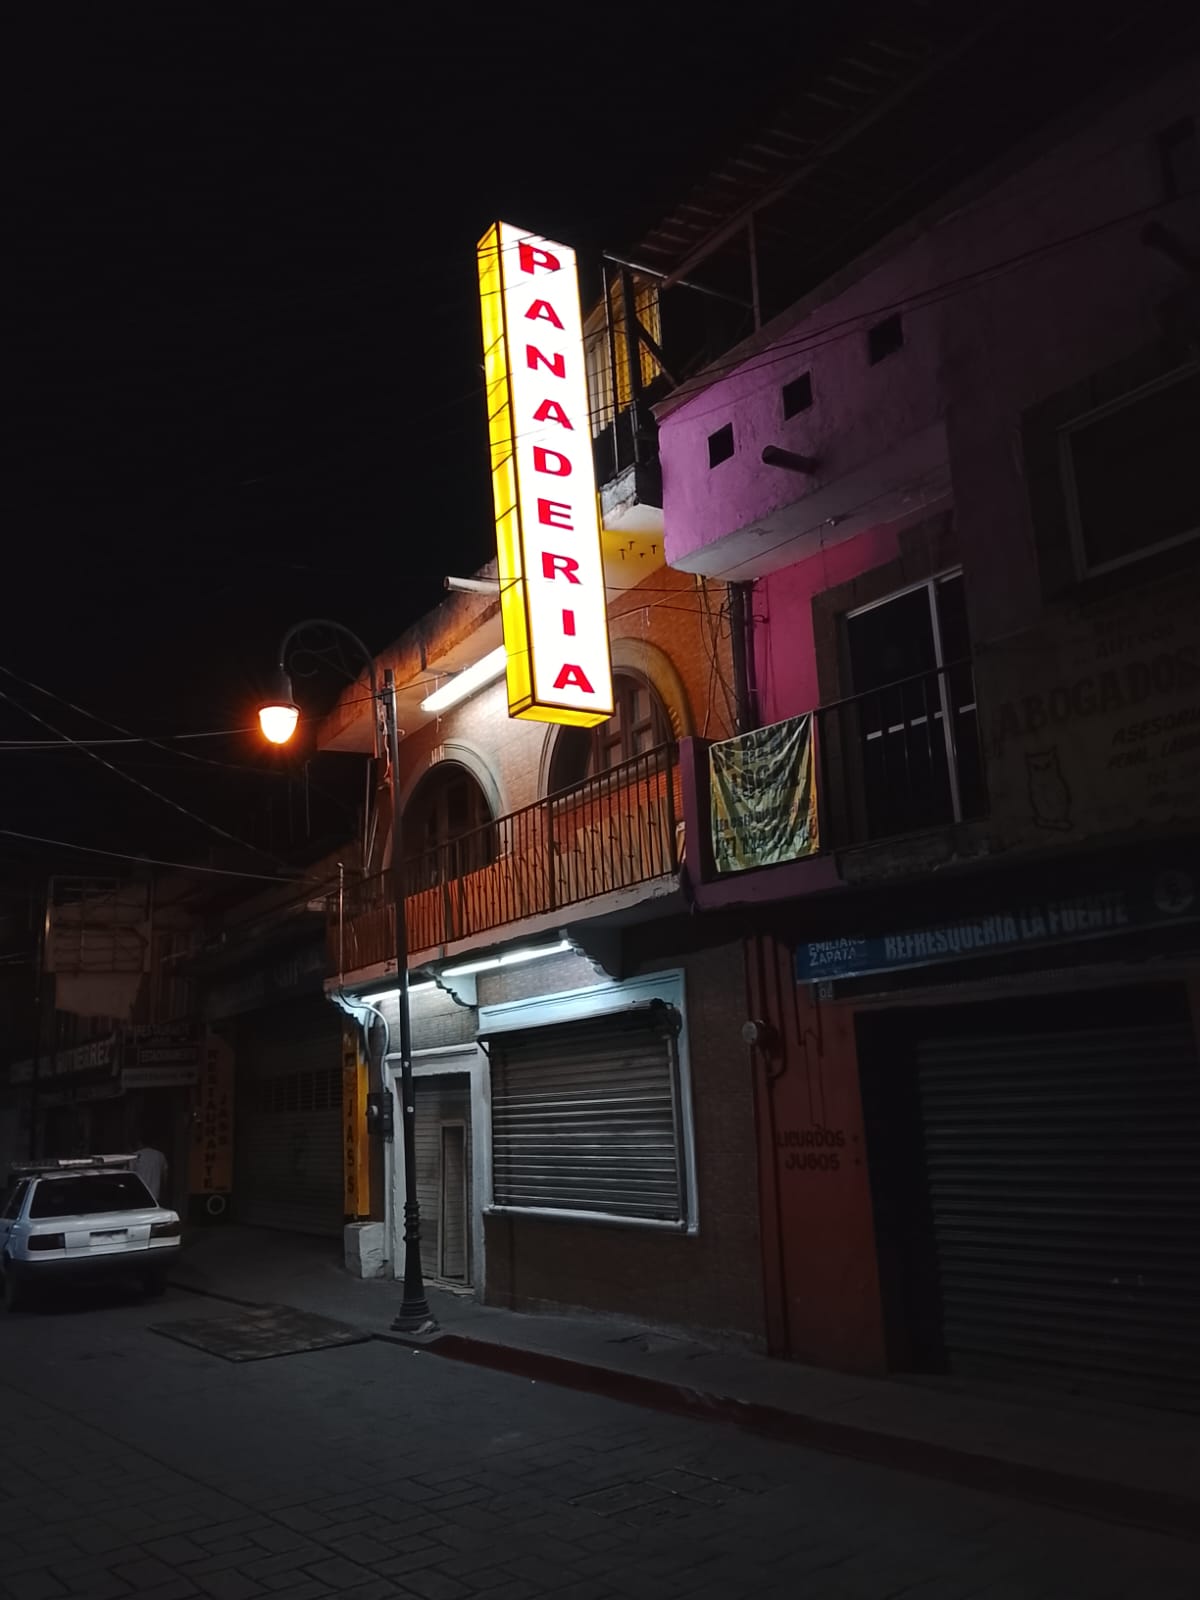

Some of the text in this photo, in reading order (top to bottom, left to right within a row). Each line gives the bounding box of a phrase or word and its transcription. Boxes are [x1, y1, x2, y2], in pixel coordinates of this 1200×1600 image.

[518, 240, 596, 694] PANADERIA
[1020, 904, 1046, 937] LA
[1047, 890, 1129, 936] FUENTE
[808, 946, 857, 967] ZAPATA
[776, 1128, 846, 1147] LICUADOS
[784, 1152, 841, 1171] JUGOS
